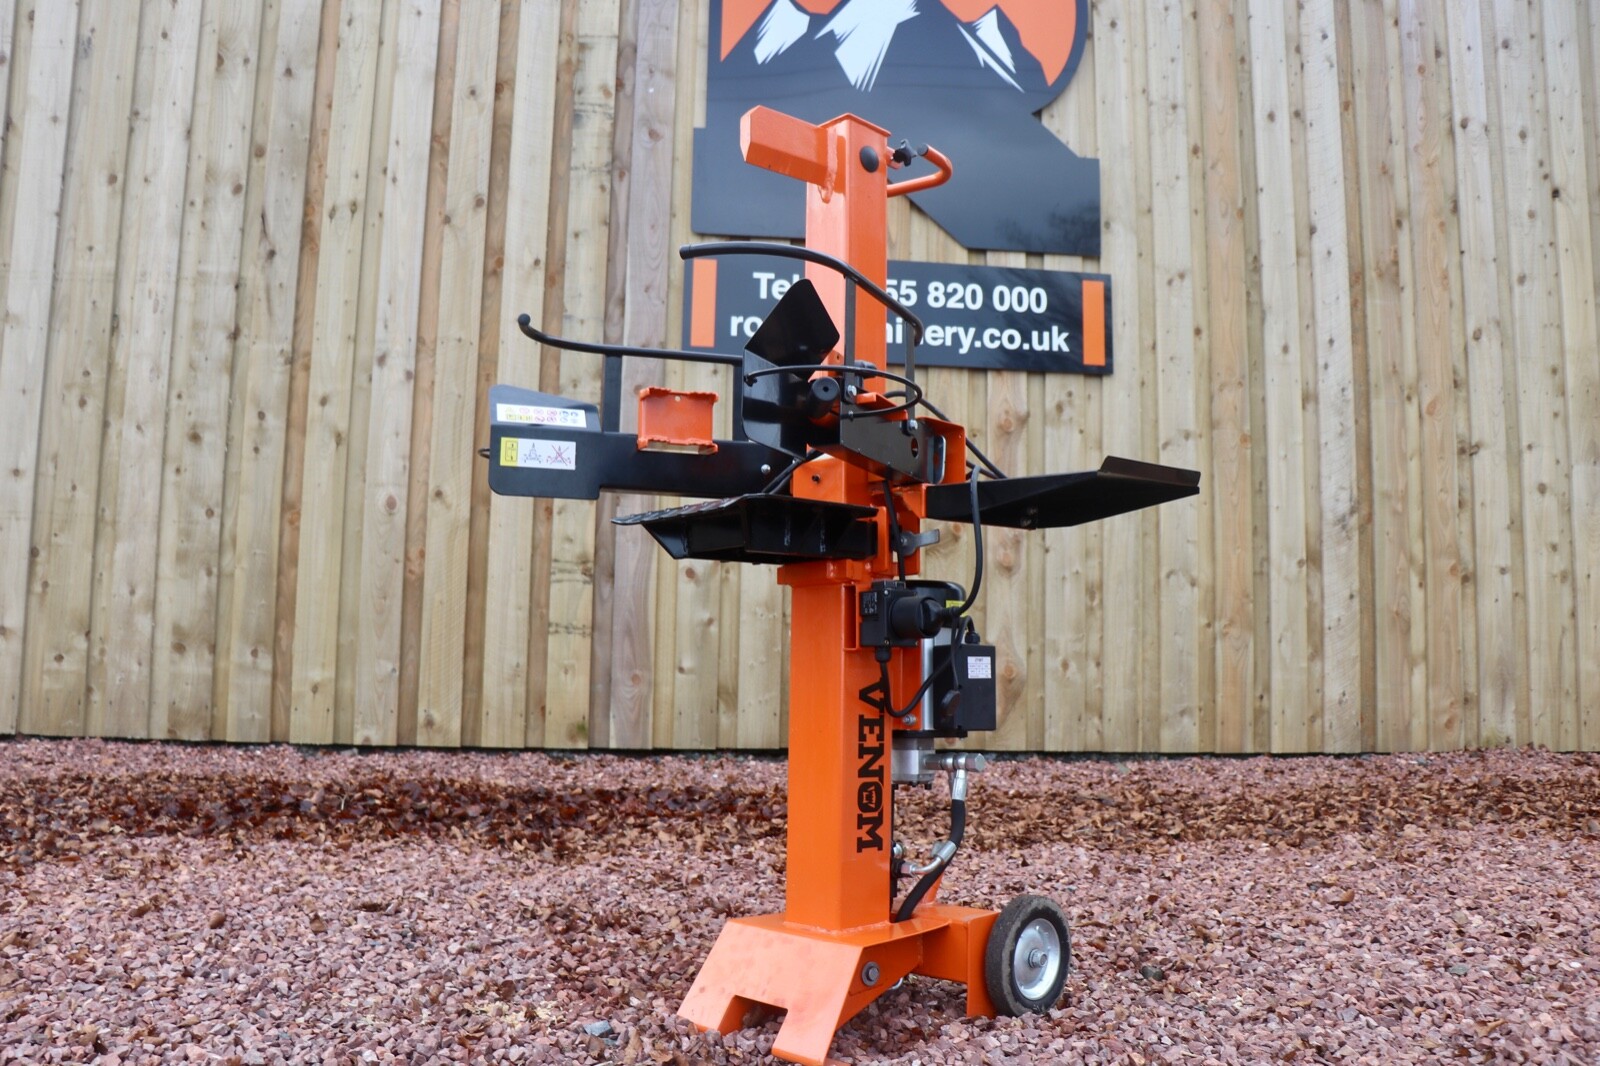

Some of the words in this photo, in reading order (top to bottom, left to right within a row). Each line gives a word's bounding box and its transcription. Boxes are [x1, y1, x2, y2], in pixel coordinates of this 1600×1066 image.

[752, 271, 800, 301] Te
[927, 281, 984, 310] 820
[992, 285, 1048, 314] 000
[856, 677, 885, 853] VENOM
